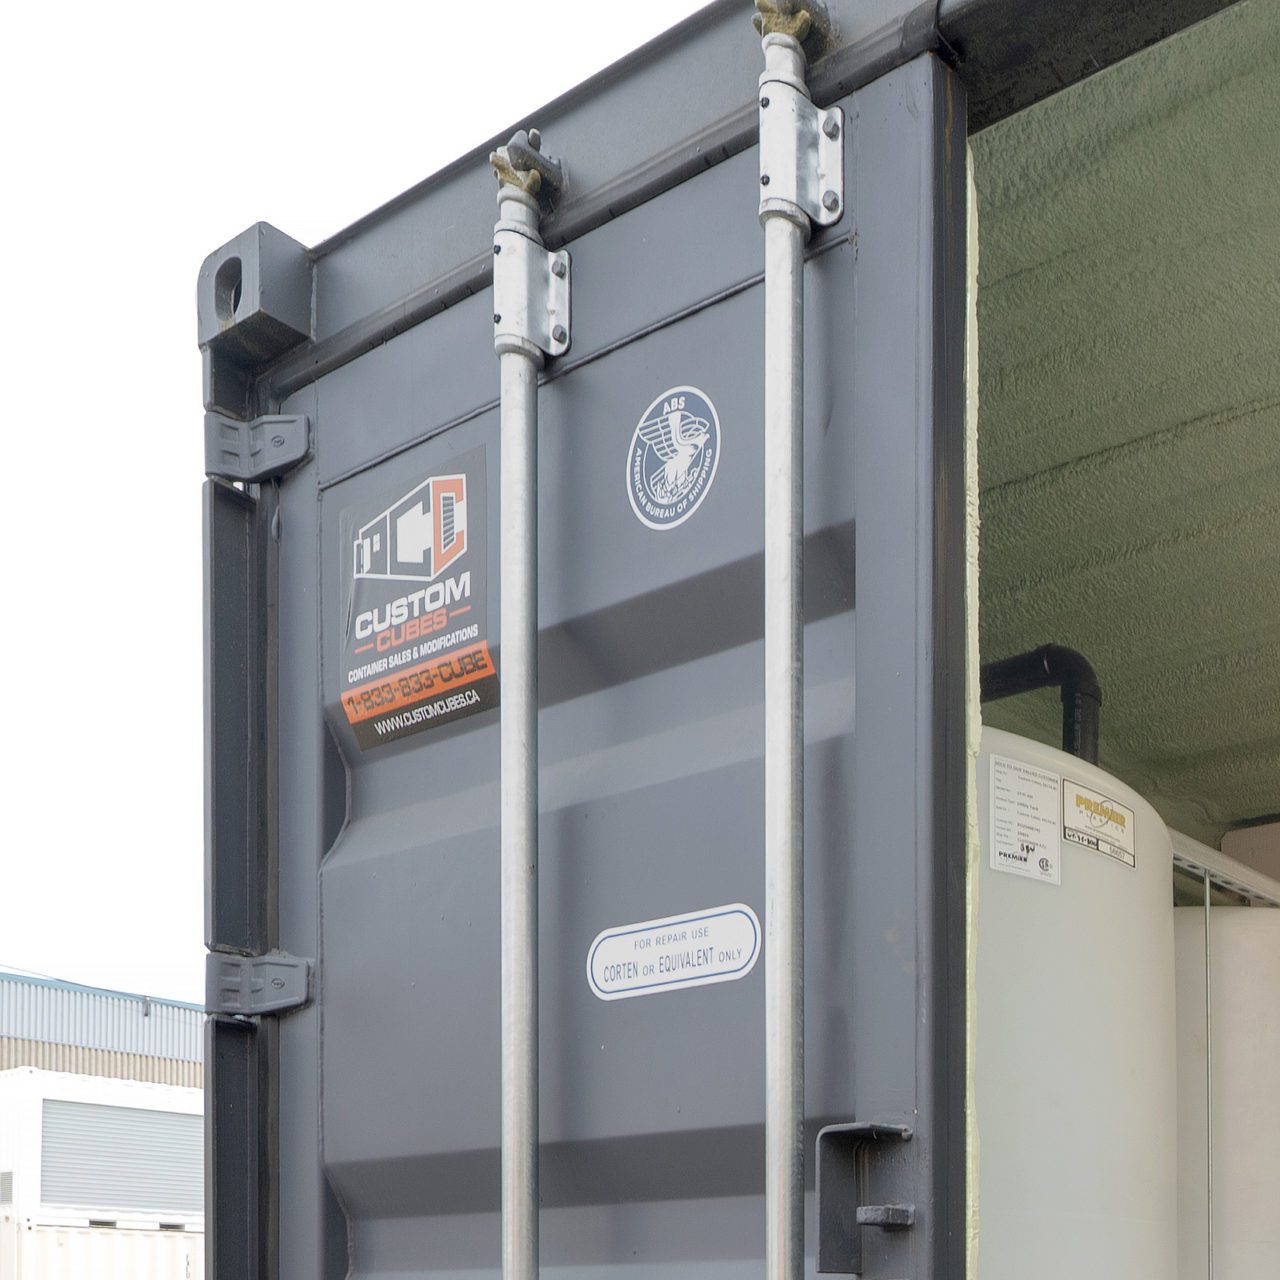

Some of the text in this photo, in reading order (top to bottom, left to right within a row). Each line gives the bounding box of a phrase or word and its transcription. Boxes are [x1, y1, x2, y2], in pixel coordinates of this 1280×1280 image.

[663, 396, 686, 415] ABS
[633, 448, 713, 519] AMERICAN BUREAU OF SHIPPING
[355, 571, 470, 640] CUSTOM
[376, 607, 447, 652] CUBES
[348, 624, 478, 684] CONTAINER SALES & MODIFICATIONS
[347, 650, 488, 715] 1-833-833-CUBE
[374, 688, 480, 736] WWW.CUSTOMCUBES.CA
[634, 926, 709, 950] FOR REPAIR USE
[604, 962, 638, 983] CORTEN
[660, 947, 714, 974] EQUIVALENT
[718, 948, 742, 963] ONLY
